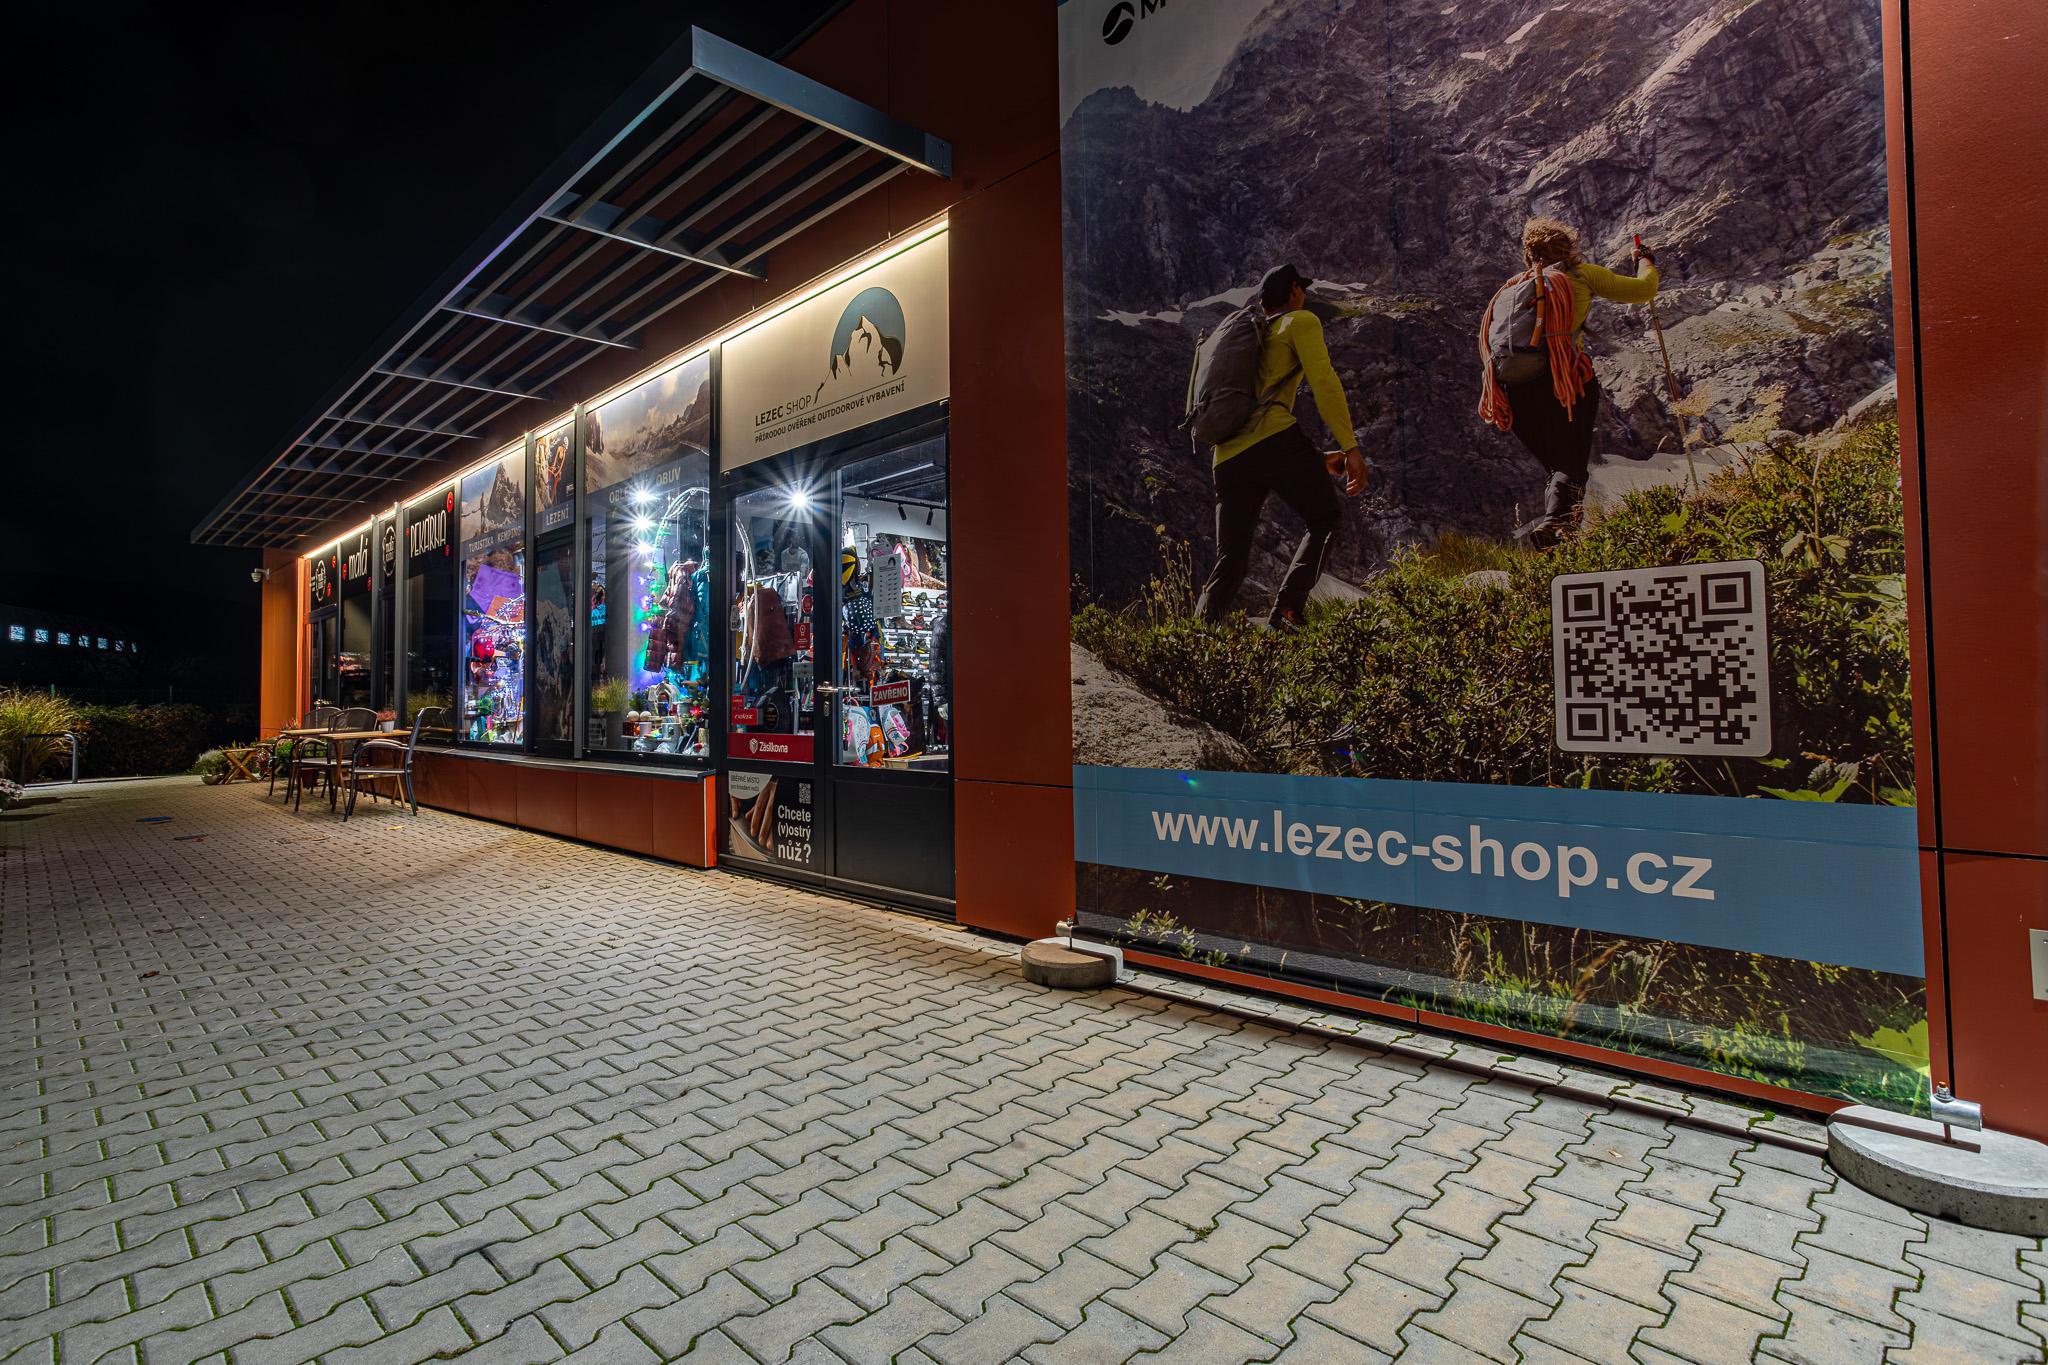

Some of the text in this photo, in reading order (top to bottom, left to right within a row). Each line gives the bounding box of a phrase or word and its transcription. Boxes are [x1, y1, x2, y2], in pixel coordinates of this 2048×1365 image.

[754, 379, 905, 444] PŘÍRODOU OVĚŘENÉ OUTDOOROVÉ VYBAVENÍ
[755, 394, 812, 427] LEZEC SHOP
[656, 466, 681, 486] OBUV
[545, 504, 569, 526] LEZENÍ
[410, 509, 447, 558] PEKÁRNA
[873, 686, 908, 702] ZAVŘENO
[759, 741, 788, 754] Zásilkovna
[777, 804, 812, 822] Chcete
[777, 821, 812, 842] (v)ostrý
[777, 839, 812, 864] nůž?
[1151, 809, 1716, 901] www.lezec-shop.cz
